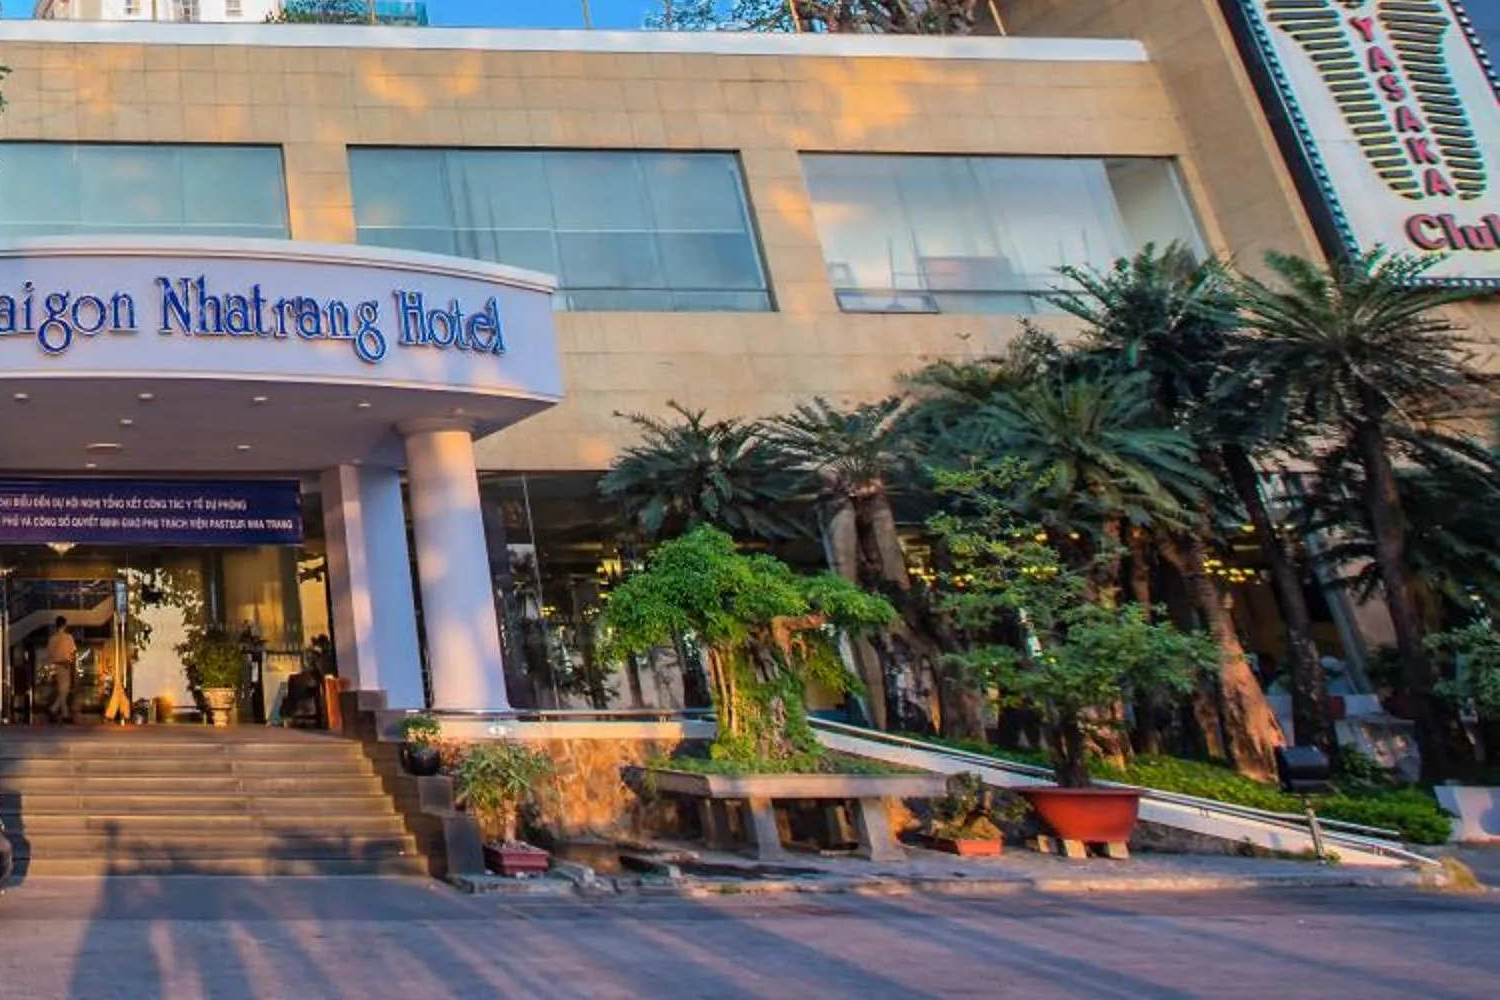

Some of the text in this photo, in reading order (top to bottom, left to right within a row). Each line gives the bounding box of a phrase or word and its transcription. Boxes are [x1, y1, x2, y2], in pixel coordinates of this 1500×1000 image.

[1348, 16, 1454, 197] YASAKA
[155, 274, 388, 363] Nhatrang
[393, 288, 506, 355] Hotel
